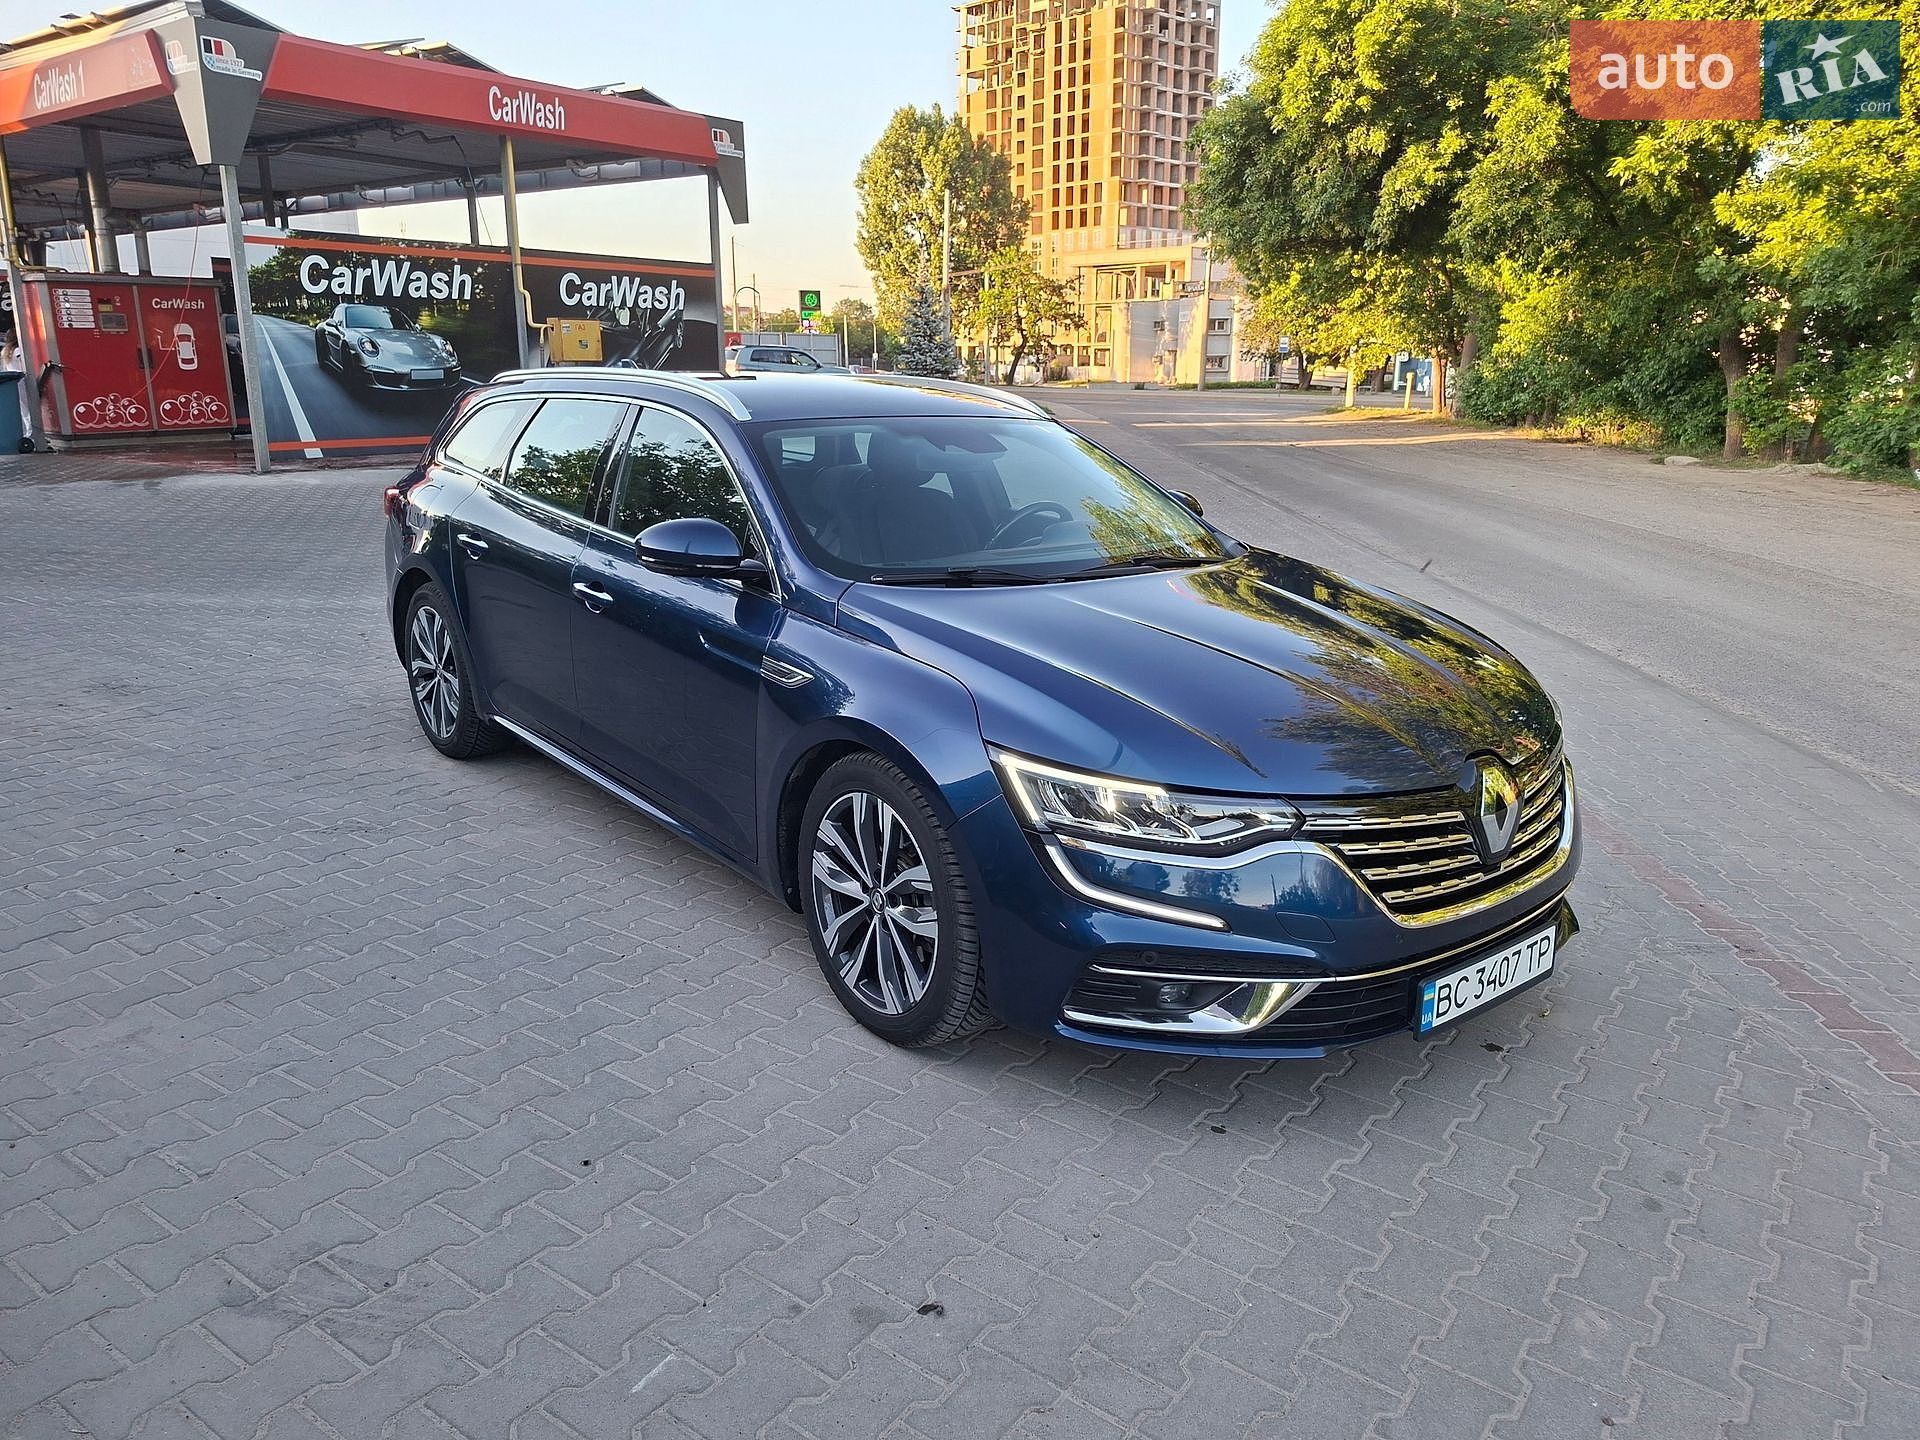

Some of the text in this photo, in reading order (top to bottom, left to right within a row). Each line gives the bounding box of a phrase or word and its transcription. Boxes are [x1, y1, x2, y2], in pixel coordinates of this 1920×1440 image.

[34, 60, 85, 110] CarWash 1
[489, 85, 565, 131] CarWash
[300, 254, 472, 300] CarWash
[559, 272, 686, 311] CarWash
[152, 298, 205, 310] CarWash
[1436, 935, 1551, 1019] BC 3407 TP
[1421, 1013, 1432, 1024] UA
